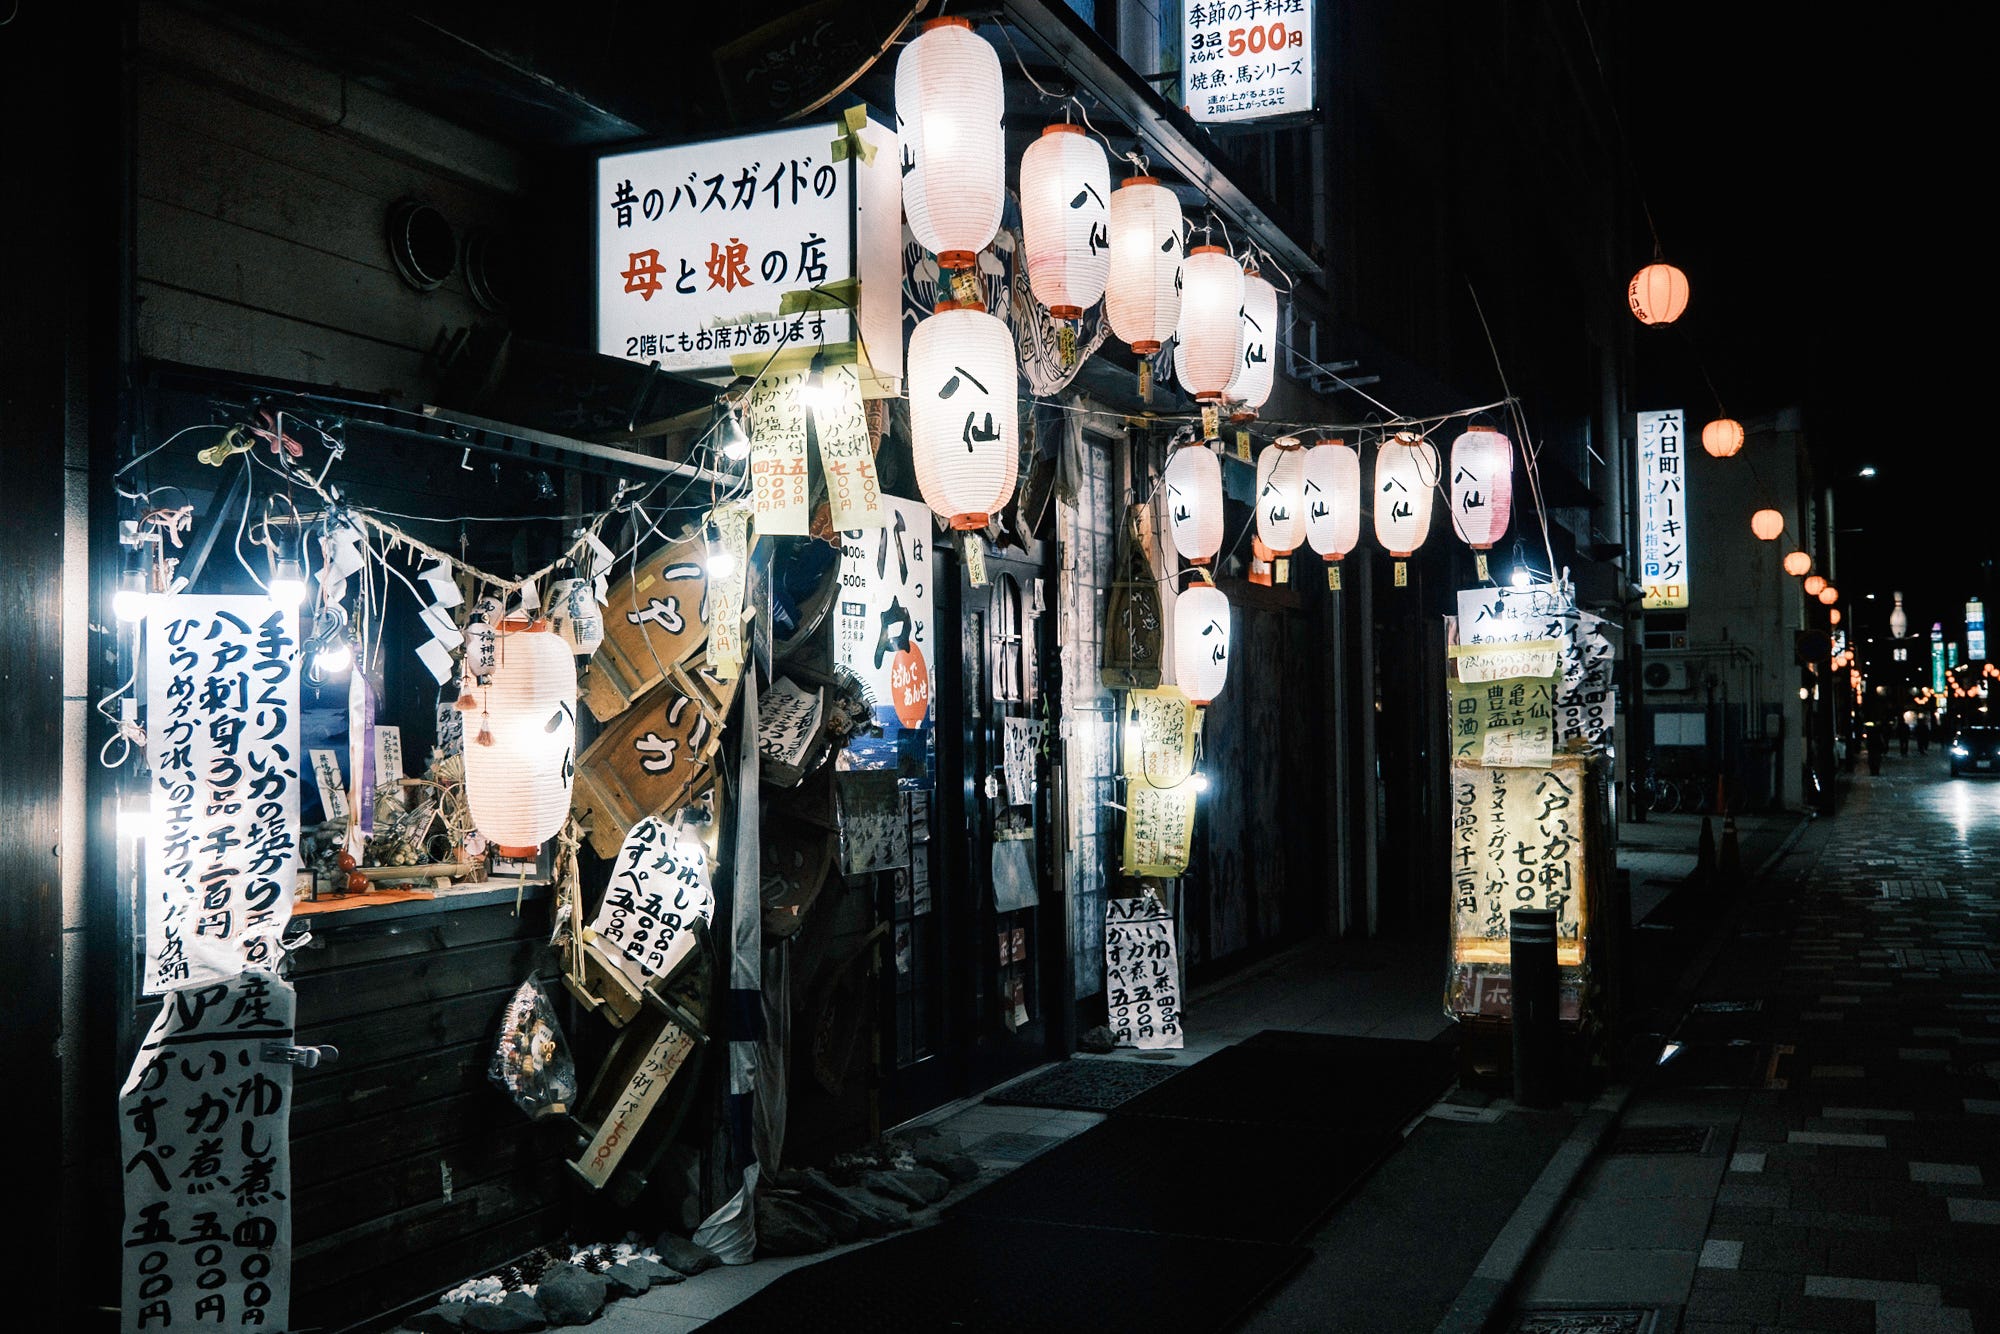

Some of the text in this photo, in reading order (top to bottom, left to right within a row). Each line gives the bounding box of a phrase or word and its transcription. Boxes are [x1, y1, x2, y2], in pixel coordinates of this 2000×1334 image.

[611, 156, 837, 229] 昔のバスガイドの
[620, 233, 828, 302] 母と娘の店
[626, 318, 826, 357] 2階にもお席があります
[938, 366, 1001, 453] 八仙
[1383, 477, 1413, 523] 八仙
[1454, 466, 1485, 514] 八仙
[1658, 413, 1683, 581] 六日町パーキング
[1648, 585, 1680, 599] 入口
[1508, 684, 1525, 726] 亀吉
[1530, 685, 1551, 719] 八仙
